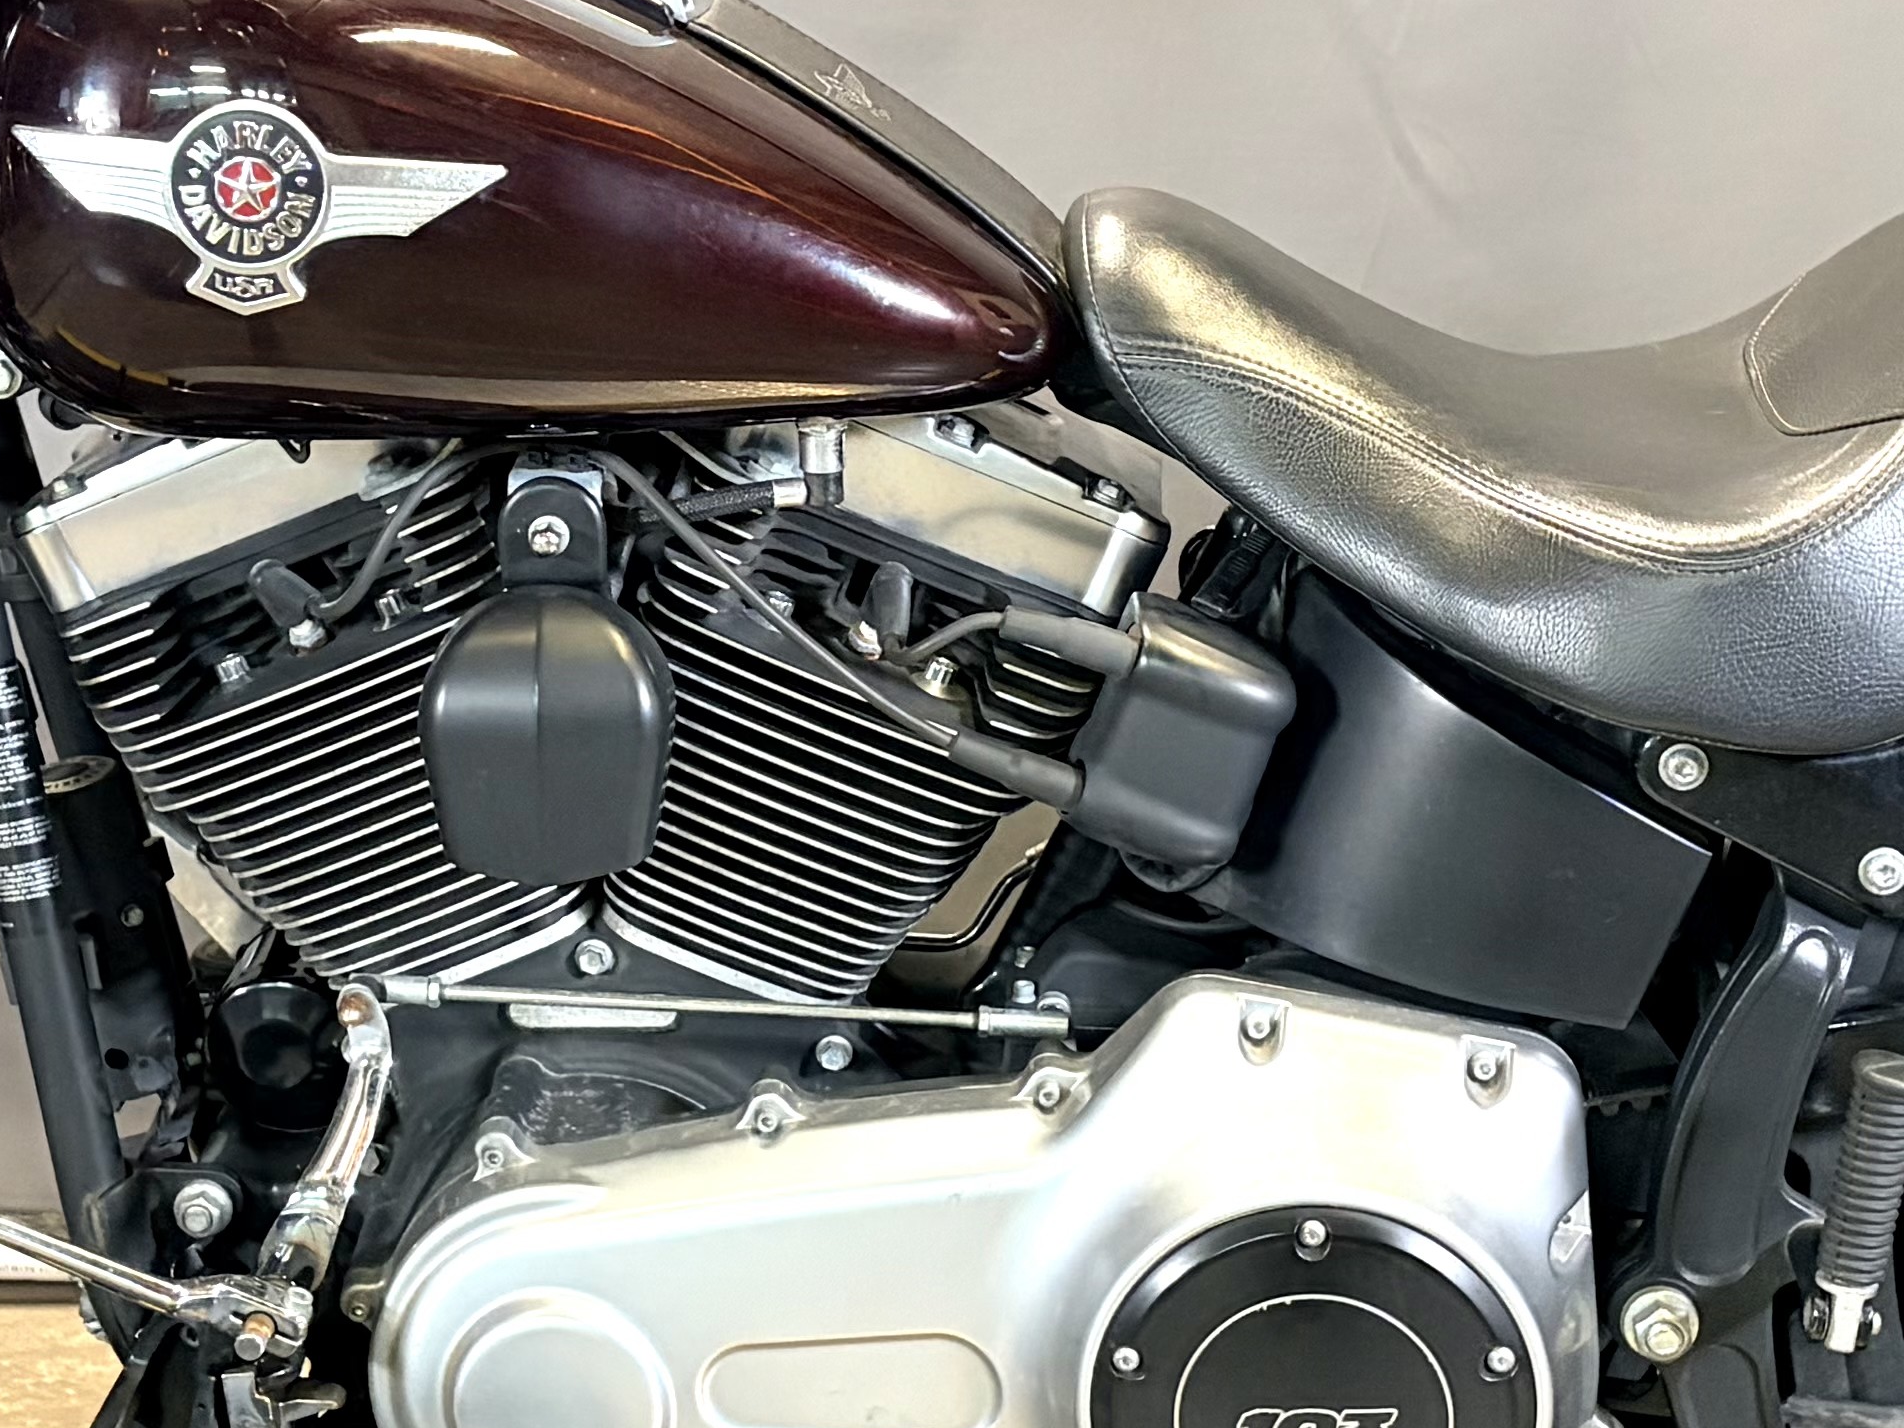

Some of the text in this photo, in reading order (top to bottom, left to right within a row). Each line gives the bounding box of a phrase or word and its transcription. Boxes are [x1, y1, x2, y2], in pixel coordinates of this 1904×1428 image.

[186, 120, 313, 174] HARLEY
[178, 184, 316, 256] DAVIDSON
[213, 272, 274, 298] USA
